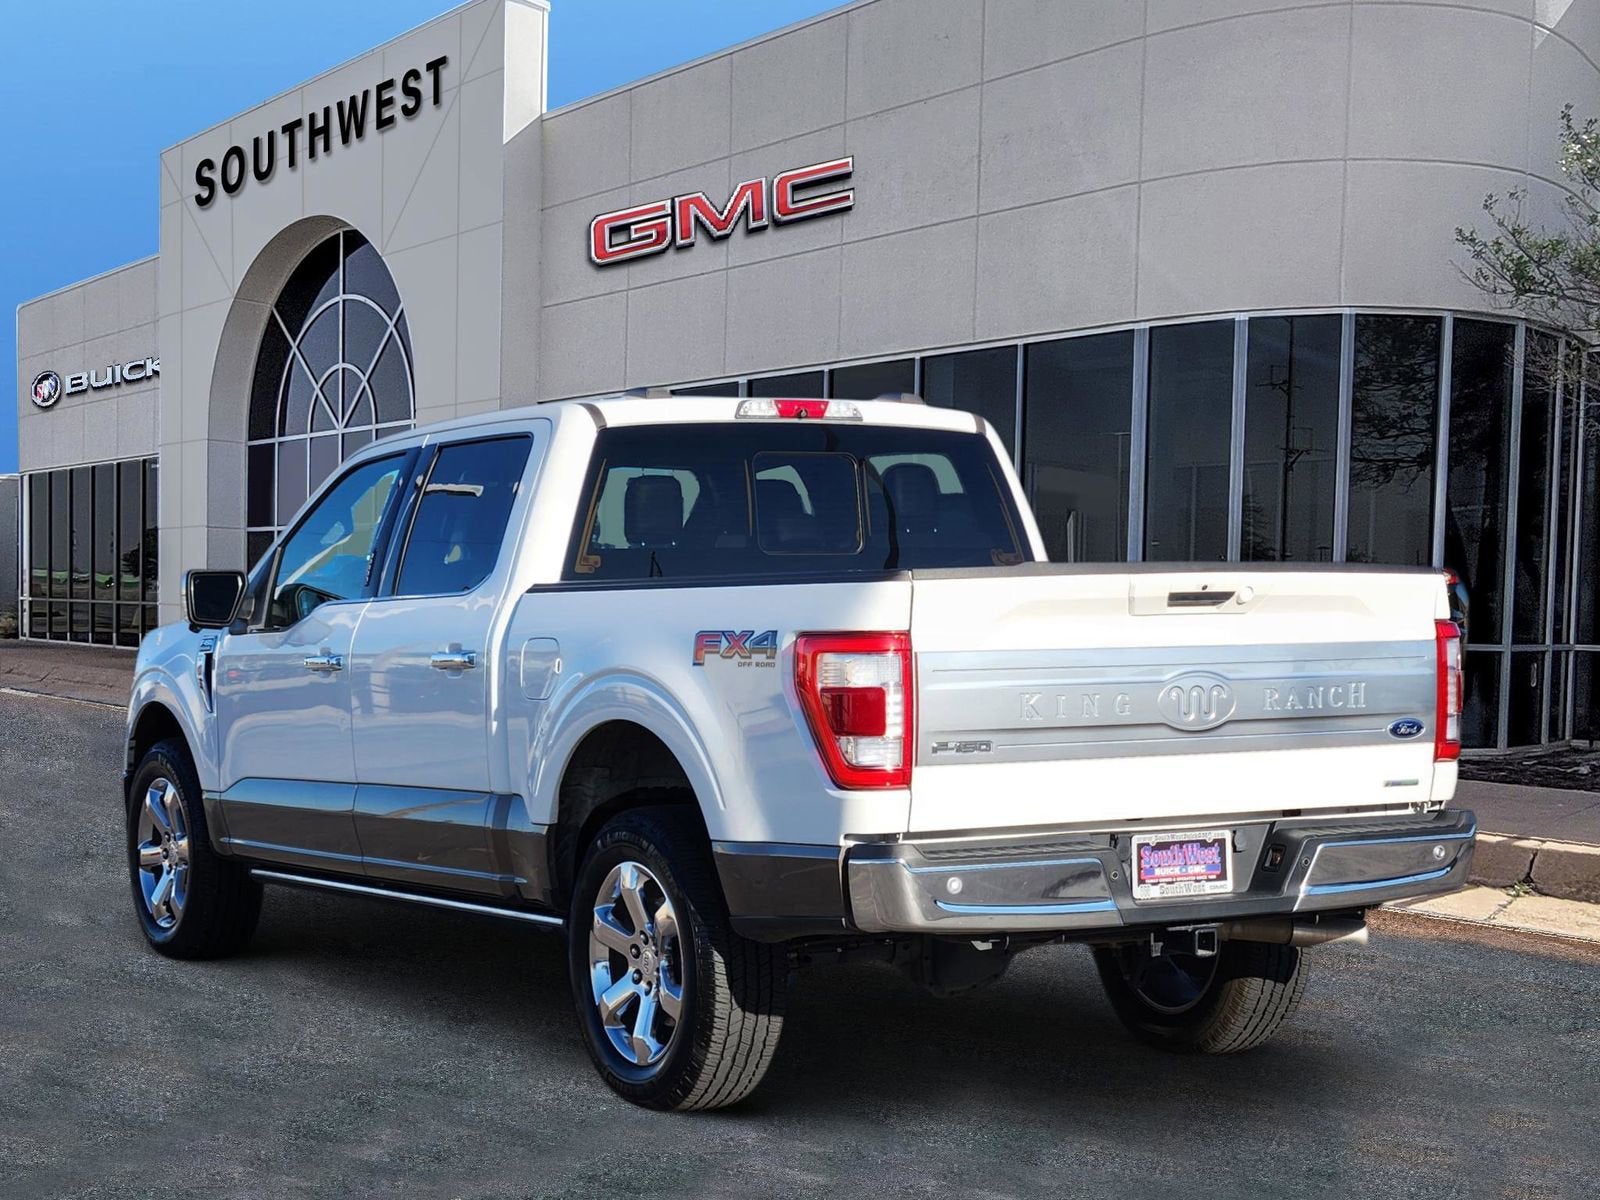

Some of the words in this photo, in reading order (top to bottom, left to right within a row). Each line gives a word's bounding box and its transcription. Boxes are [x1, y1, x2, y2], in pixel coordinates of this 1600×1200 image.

[194, 55, 448, 207] SOUTHWEST
[588, 155, 854, 266] GMC
[65, 357, 159, 395] BUICK
[692, 630, 778, 666] FX4
[1019, 692, 1131, 721] KING
[1262, 682, 1367, 711] RANCH
[1141, 842, 1221, 867] SouthWest
[1159, 882, 1206, 895] SouthWest
